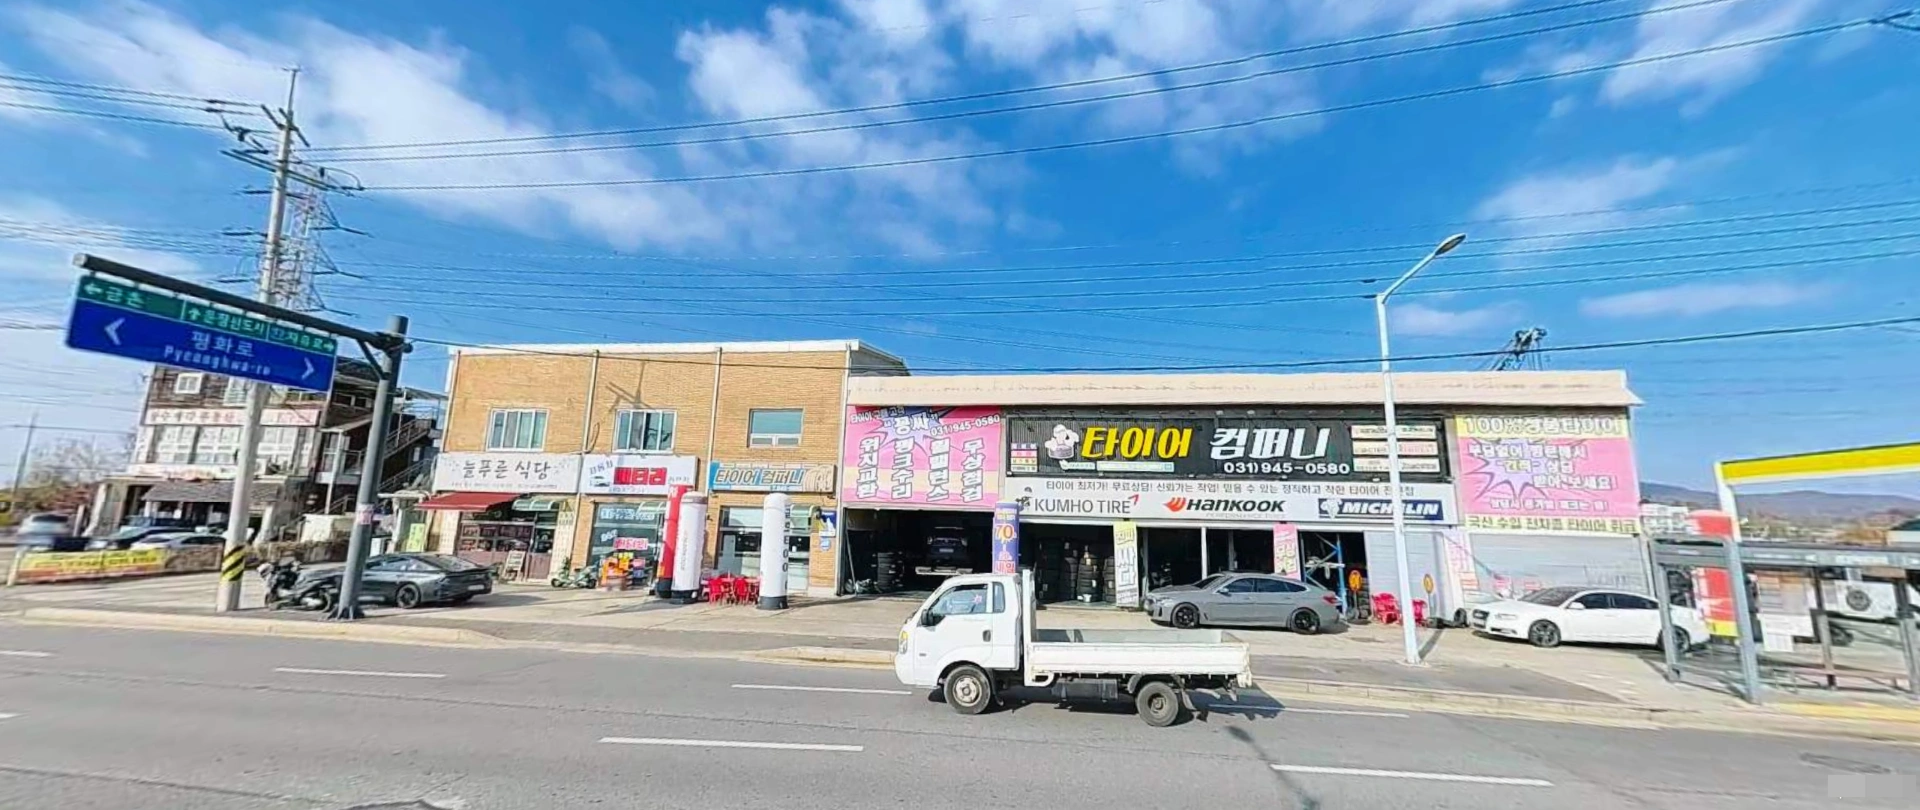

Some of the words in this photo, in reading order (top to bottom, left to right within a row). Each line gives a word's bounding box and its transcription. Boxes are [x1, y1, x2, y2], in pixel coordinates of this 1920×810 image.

[105, 286, 145, 309] 금촌
[191, 330, 256, 358] 평화로
[1081, 425, 1193, 460] 타이어
[1209, 427, 1331, 460] 컴퍼니
[463, 459, 509, 479] 늘푸른
[514, 460, 551, 480] 식당
[715, 467, 759, 486] 타이어
[760, 468, 805, 486] 컴퍼니
[961, 437, 985, 503] 무상점검
[1223, 461, 1350, 475] 031)945-0580
[1046, 480, 1074, 491] 타이어
[1078, 480, 1109, 491] 최저가!
[1112, 481, 1153, 493] 무료상담!
[1156, 482, 1194, 493] 신뢰가는
[1197, 483, 1220, 493] 작업!
[1222, 483, 1242, 494] 믿을
[1246, 484, 1256, 494] 수
[1260, 484, 1278, 494] 있는
[1282, 485, 1322, 495] 정직하고
[1349, 485, 1380, 496] 타이어
[1384, 486, 1415, 497] 전점
[1034, 498, 1093, 514] KUMHO
[1099, 500, 1131, 514] TIRE
[1342, 501, 1439, 515] MICHLIN
[1468, 515, 1494, 528] 국산
[1498, 517, 1523, 529] 수입
[1567, 519, 1607, 531] 타이어
[1610, 520, 1637, 532] 취급
